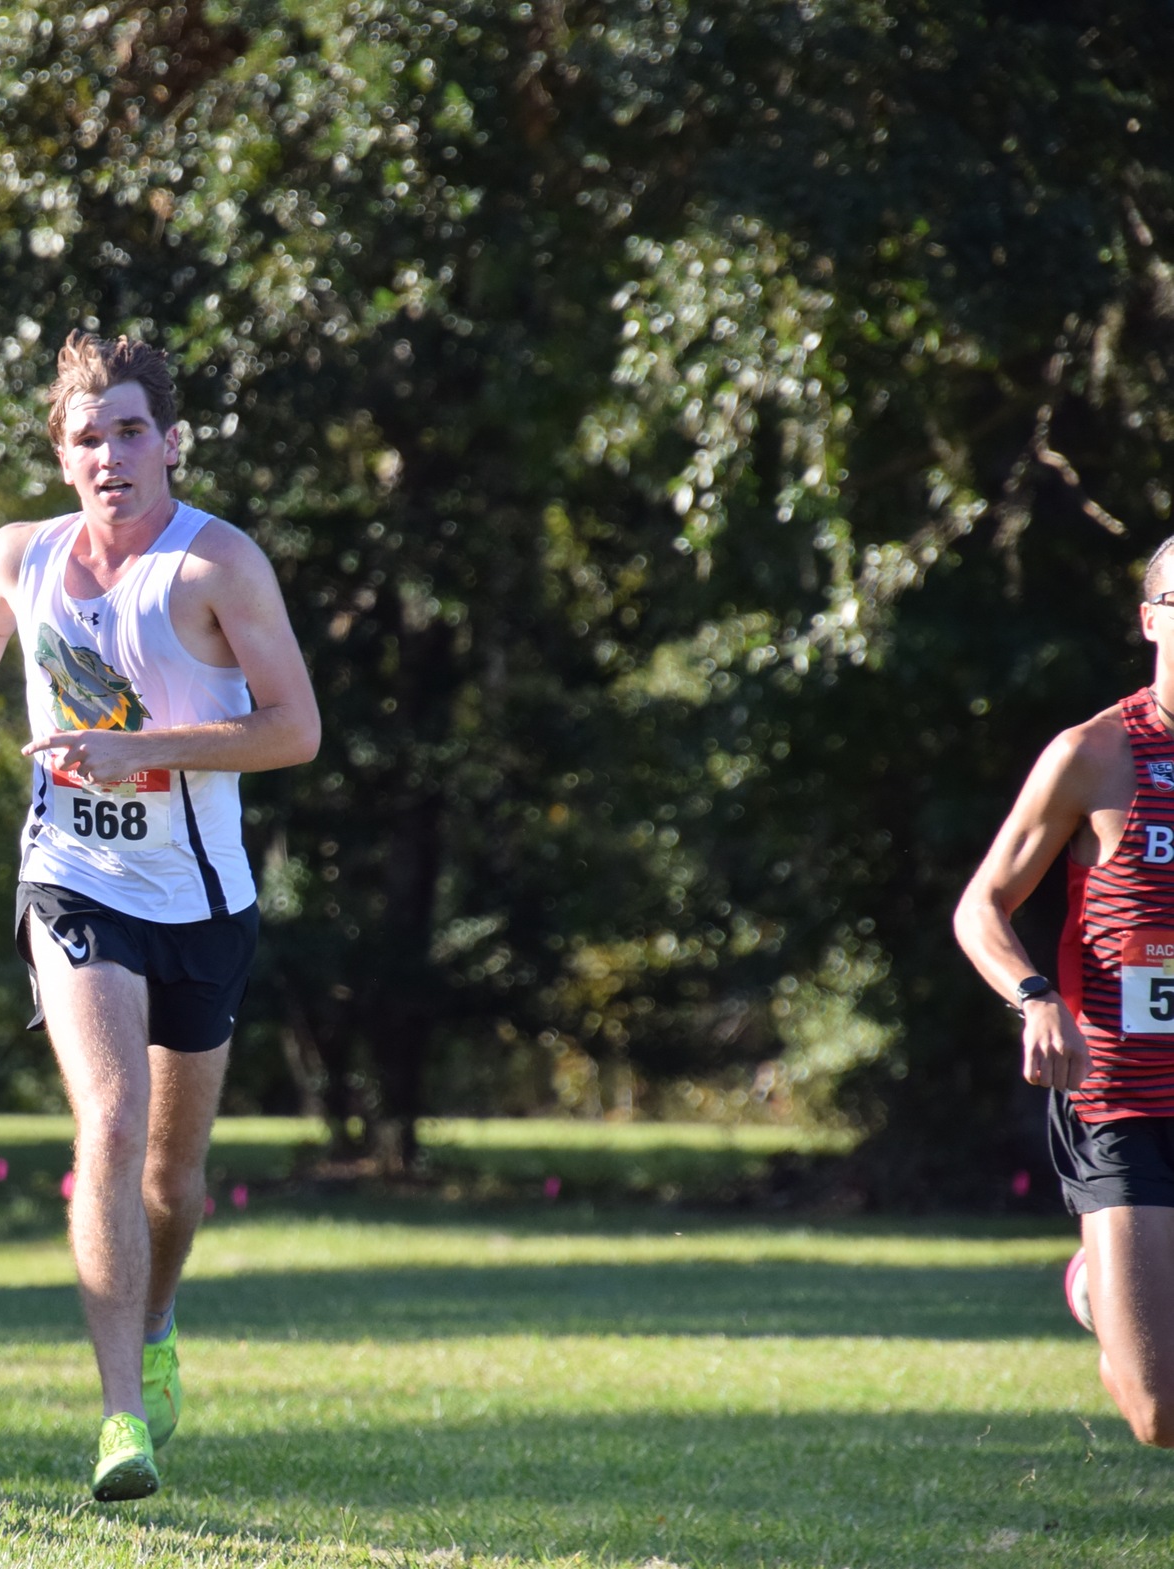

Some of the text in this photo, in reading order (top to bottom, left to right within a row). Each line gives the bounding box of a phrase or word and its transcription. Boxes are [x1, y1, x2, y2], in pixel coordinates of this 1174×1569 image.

[73, 797, 147, 840] 568
[1143, 825, 1174, 864] B
[1146, 944, 1174, 956] RAC
[1149, 978, 1174, 1021] 5
